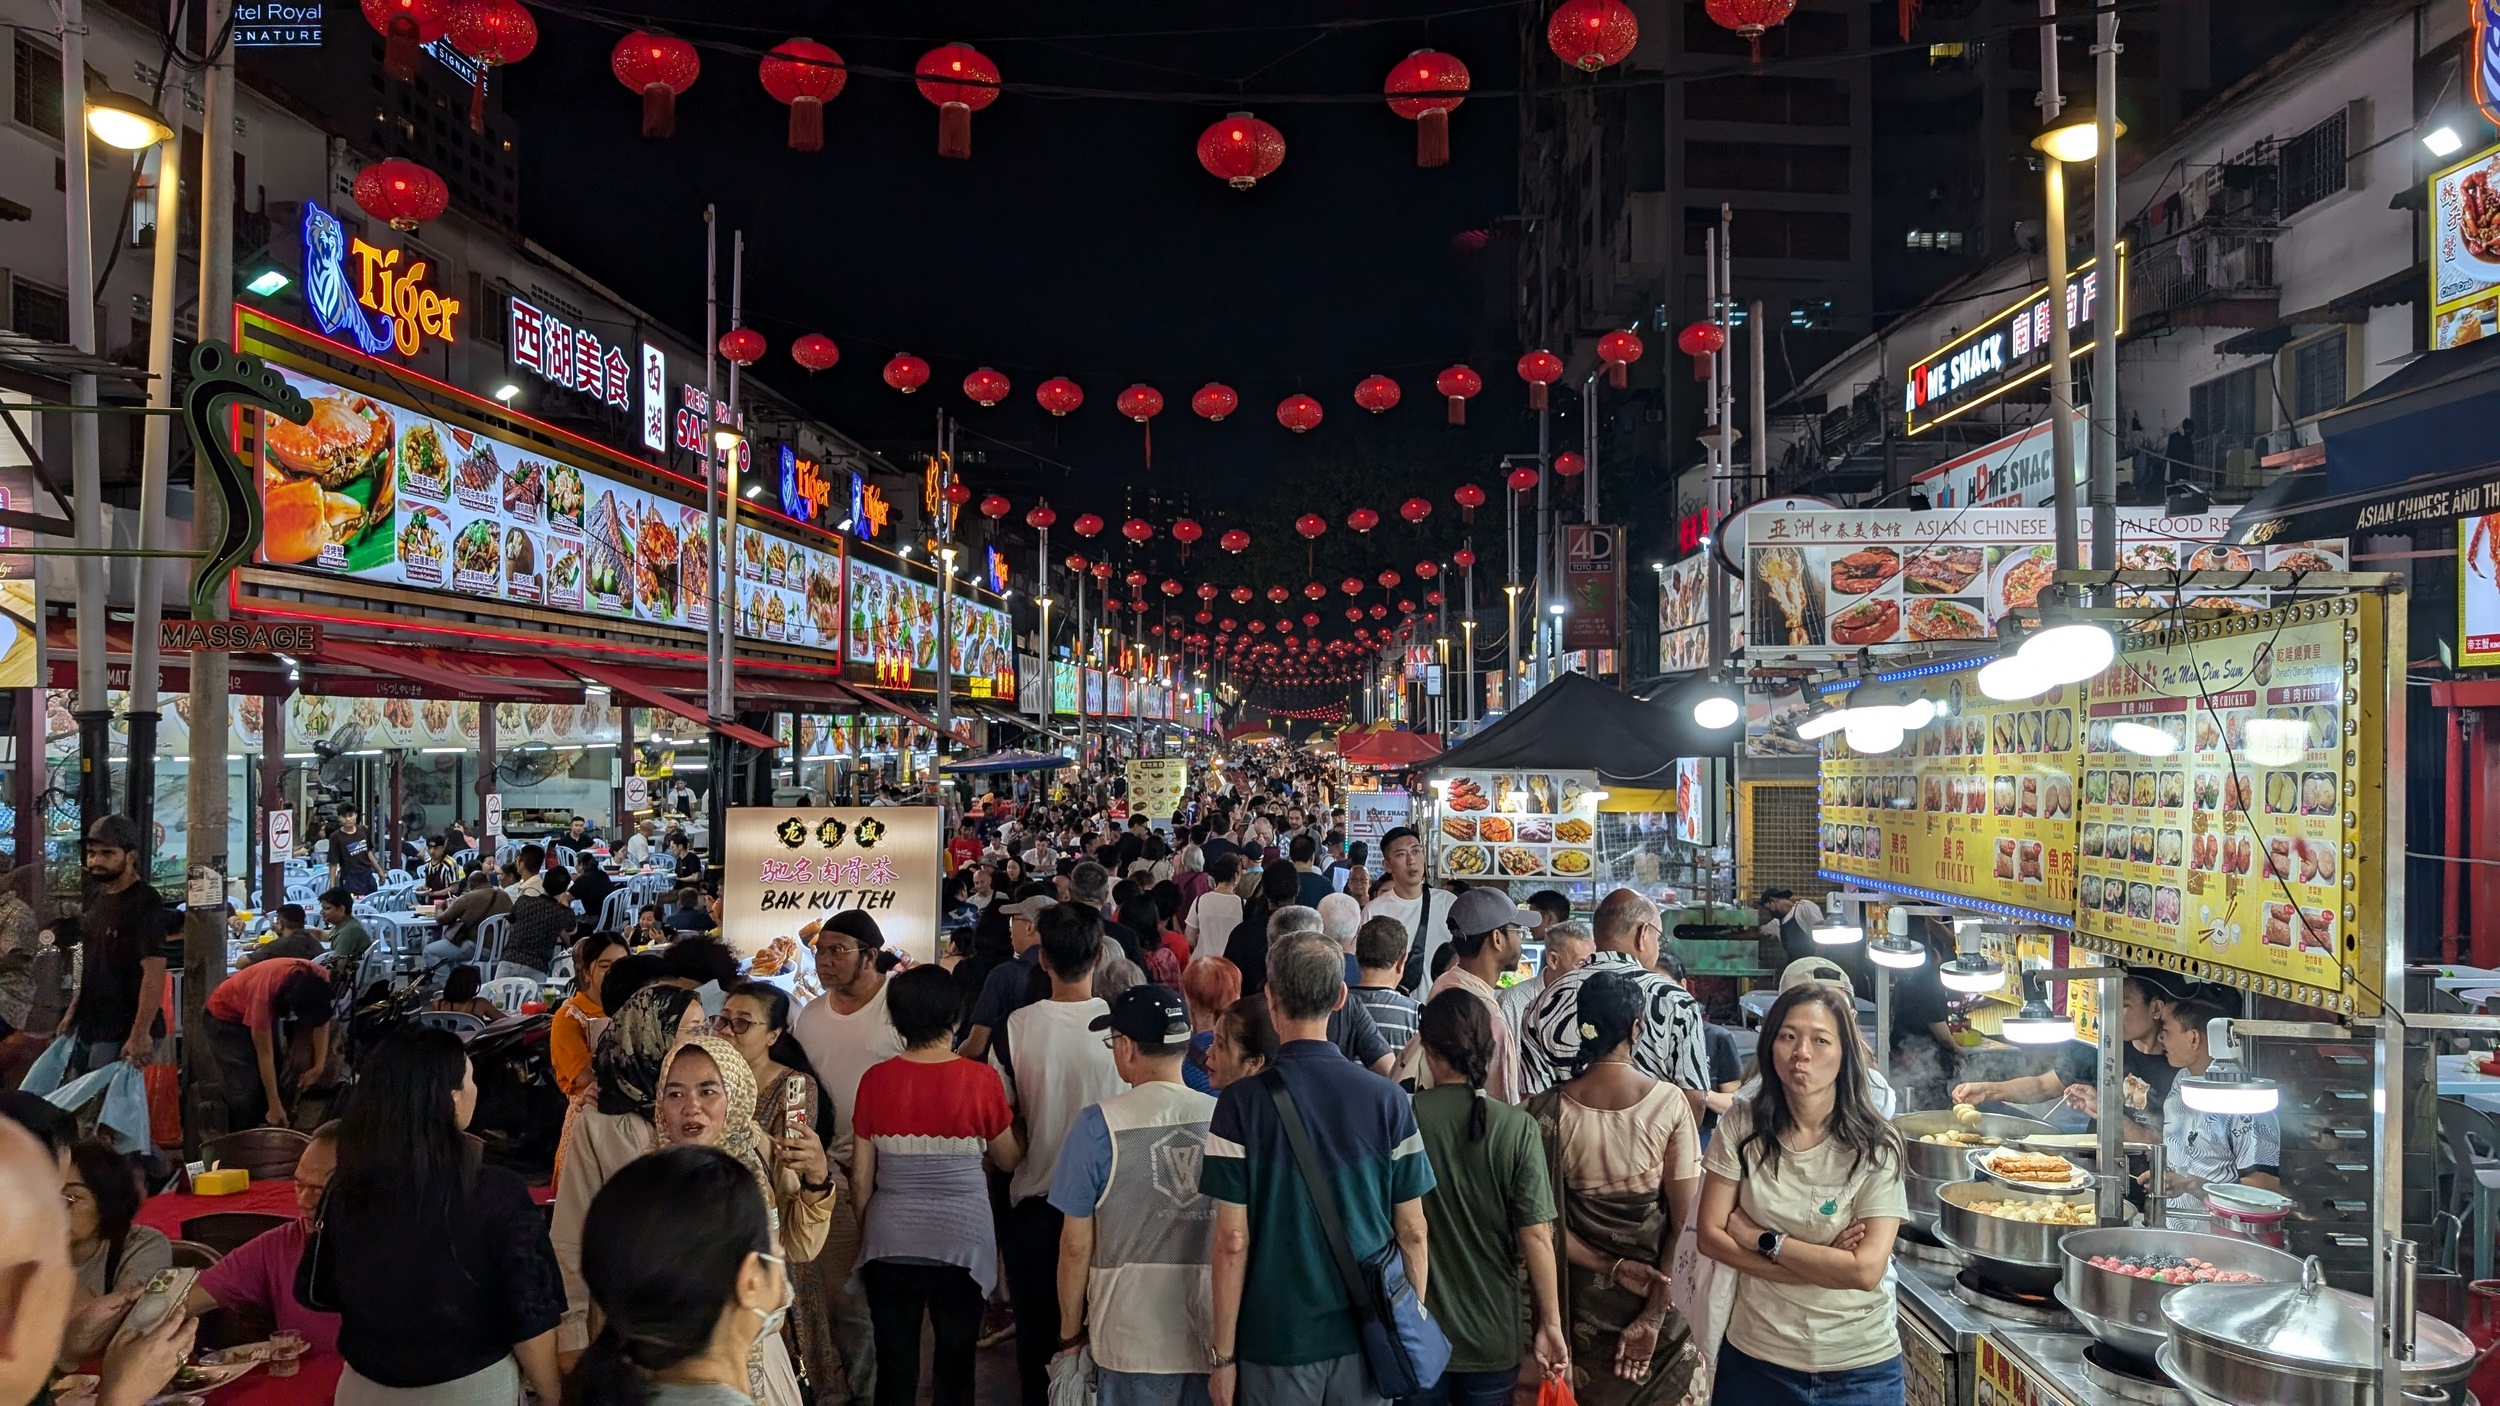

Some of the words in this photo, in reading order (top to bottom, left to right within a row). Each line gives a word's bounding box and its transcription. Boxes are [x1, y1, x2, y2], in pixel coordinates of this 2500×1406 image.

[268, 3, 322, 24] Royal
[234, 31, 322, 41] GNATURE
[438, 48, 489, 92] SIGNATUE
[352, 238, 460, 356] Tiger
[2458, 278, 2474, 293] Crab
[511, 296, 630, 411] 西湖美食
[1905, 363, 1948, 413] HOME
[1951, 333, 2002, 389] SNACK
[645, 354, 663, 443] 西湖
[796, 459, 831, 519] Tiger
[1967, 462, 2007, 504] HOME
[2010, 449, 2055, 489] SNAC
[2357, 501, 2395, 531] ASIAN
[2397, 492, 2450, 520] CHINESE
[2452, 487, 2480, 515] AND
[1914, 518, 1967, 536] ASIAN
[1972, 518, 2047, 535] CHINESE
[2149, 516, 2205, 534] FOOD
[1569, 530, 1611, 560] 4D
[158, 623, 314, 650] MASSAGE
[1407, 646, 1432, 664] KK
[2162, 666, 2177, 689] Fat
[2201, 660, 2220, 682] Dim
[2223, 658, 2245, 680] Sum
[2220, 694, 2248, 707] CHICKEN
[2303, 687, 2321, 700] FISH
[2138, 702, 2154, 713] PORK
[759, 855, 900, 887] 驰名肉骨茶
[1889, 856, 1910, 875] PORK
[1936, 862, 1975, 885] CHICKEN
[761, 890, 805, 911] BAK
[807, 889, 852, 910] KUT
[855, 889, 897, 910] TEH
[2232, 1122, 2267, 1139] Expedia
